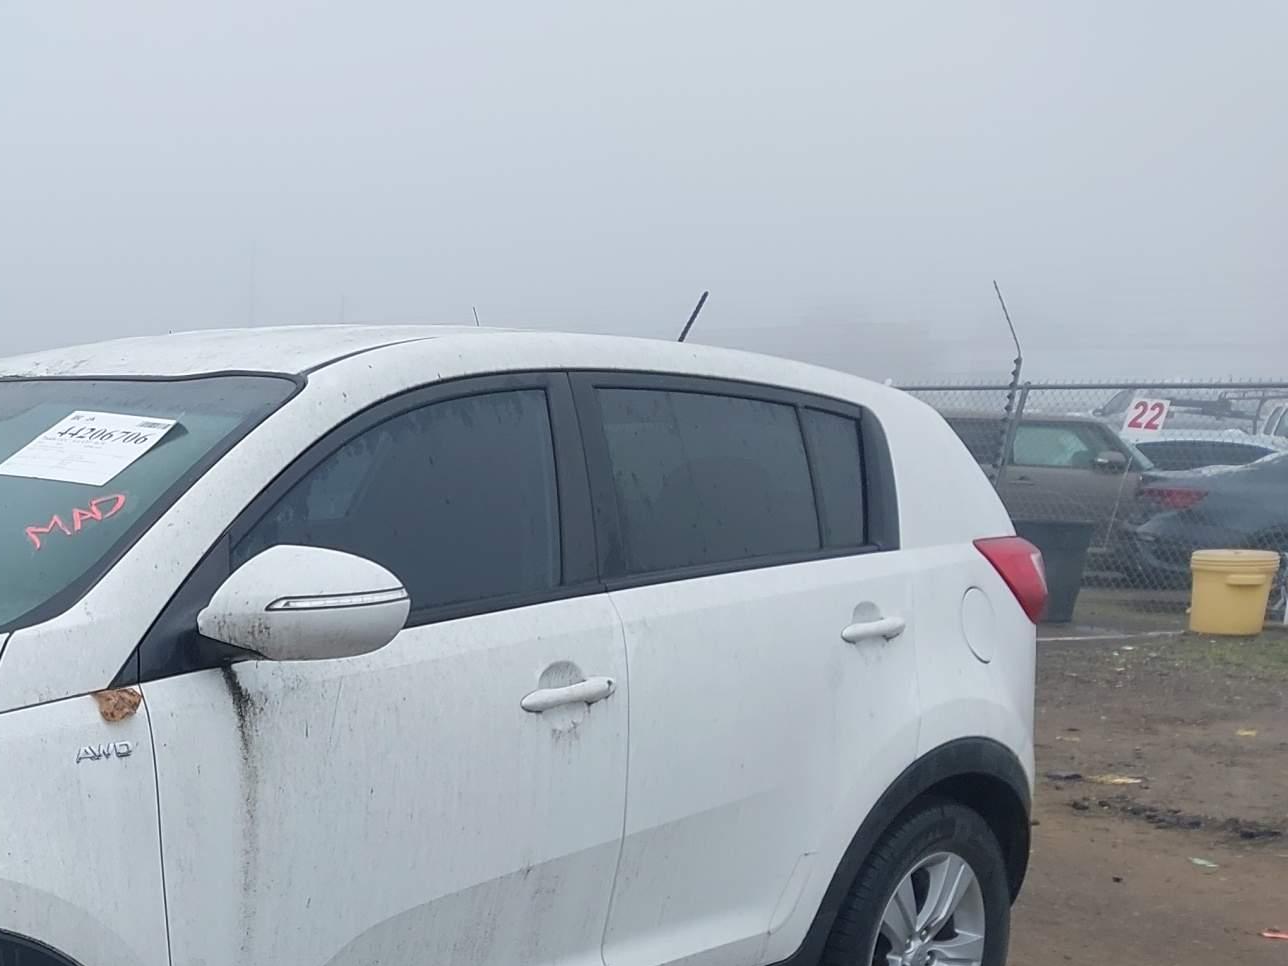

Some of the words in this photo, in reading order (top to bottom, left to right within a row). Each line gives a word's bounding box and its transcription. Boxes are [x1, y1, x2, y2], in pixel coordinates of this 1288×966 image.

[1128, 401, 1165, 430] 22
[57, 426, 153, 445] 44206706
[25, 493, 126, 550] MAD
[76, 742, 132, 764] AWD
